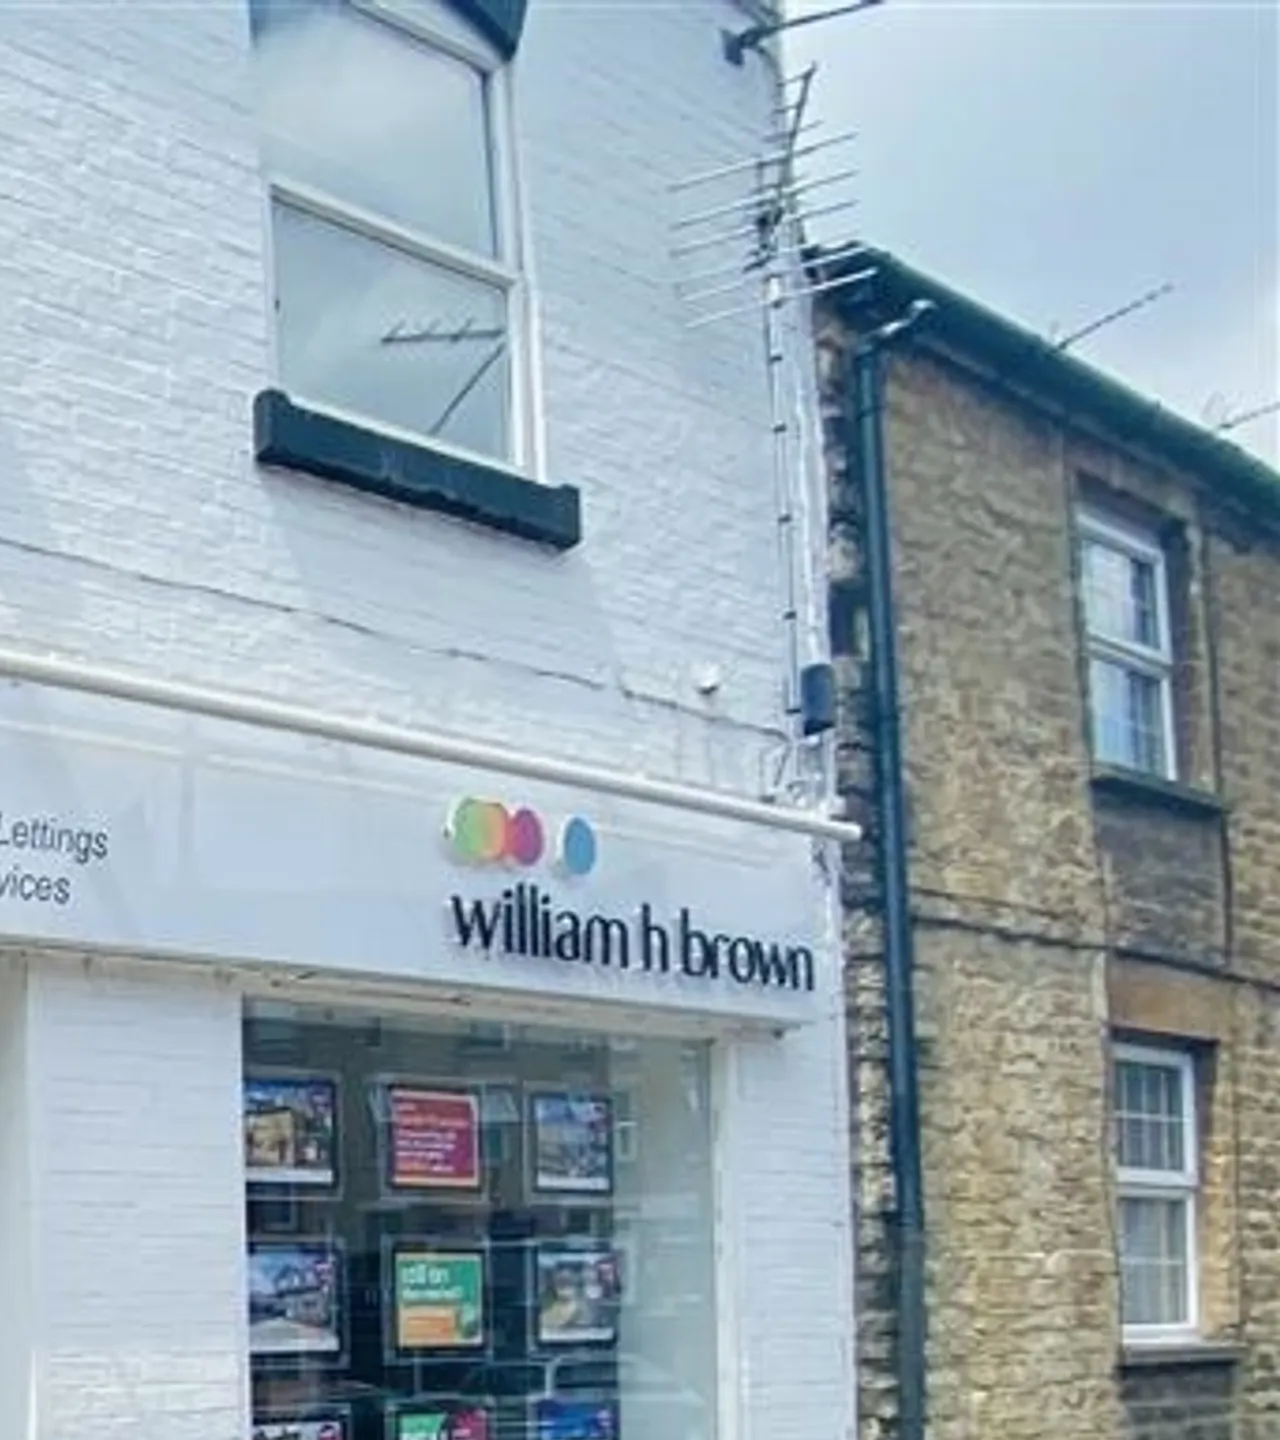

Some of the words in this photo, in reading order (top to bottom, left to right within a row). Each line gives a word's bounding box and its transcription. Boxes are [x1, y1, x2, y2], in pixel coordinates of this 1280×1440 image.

[450, 882, 629, 970] william
[641, 903, 670, 974] h
[679, 907, 815, 991] brown
